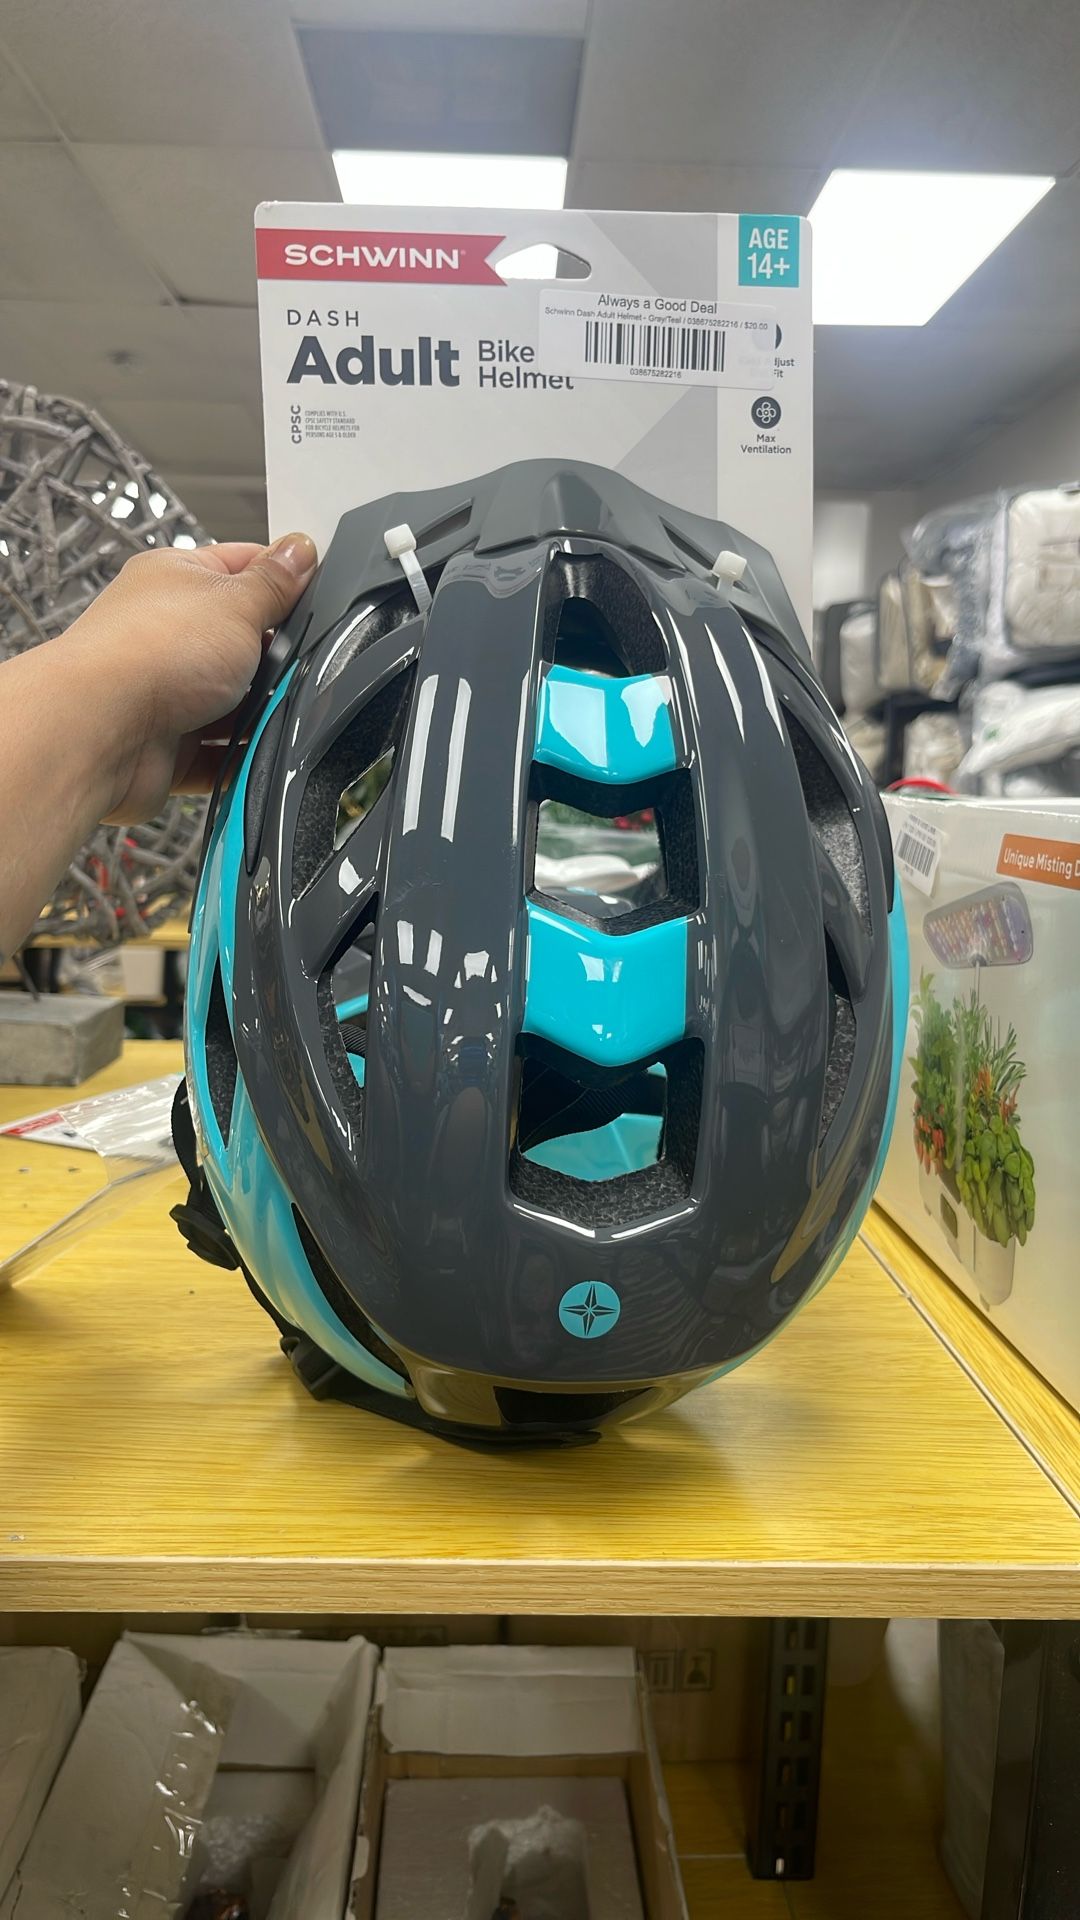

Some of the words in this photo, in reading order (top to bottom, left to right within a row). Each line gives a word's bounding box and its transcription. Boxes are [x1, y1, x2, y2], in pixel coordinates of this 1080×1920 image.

[748, 227, 789, 250] AGE
[284, 243, 460, 270] SCHWINN
[747, 252, 790, 280] 14+
[545, 306, 575, 316] Schwinn
[576, 309, 596, 317] Dash
[596, 310, 616, 319] Adult
[617, 312, 642, 320] Helmet
[597, 293, 640, 311] Always
[643, 299, 651, 309] a
[654, 298, 687, 312] Good
[690, 301, 718, 314] Deal
[286, 309, 360, 327] DASH
[286, 335, 460, 387] Adult
[478, 340, 535, 363] Bike
[478, 366, 575, 390] Helmet
[290, 405, 302, 444] CPSC
[740, 444, 792, 454] Ventilation
[756, 434, 776, 443] Max
[1003, 847, 1035, 870] Unique
[1035, 853, 1073, 880] Misting
